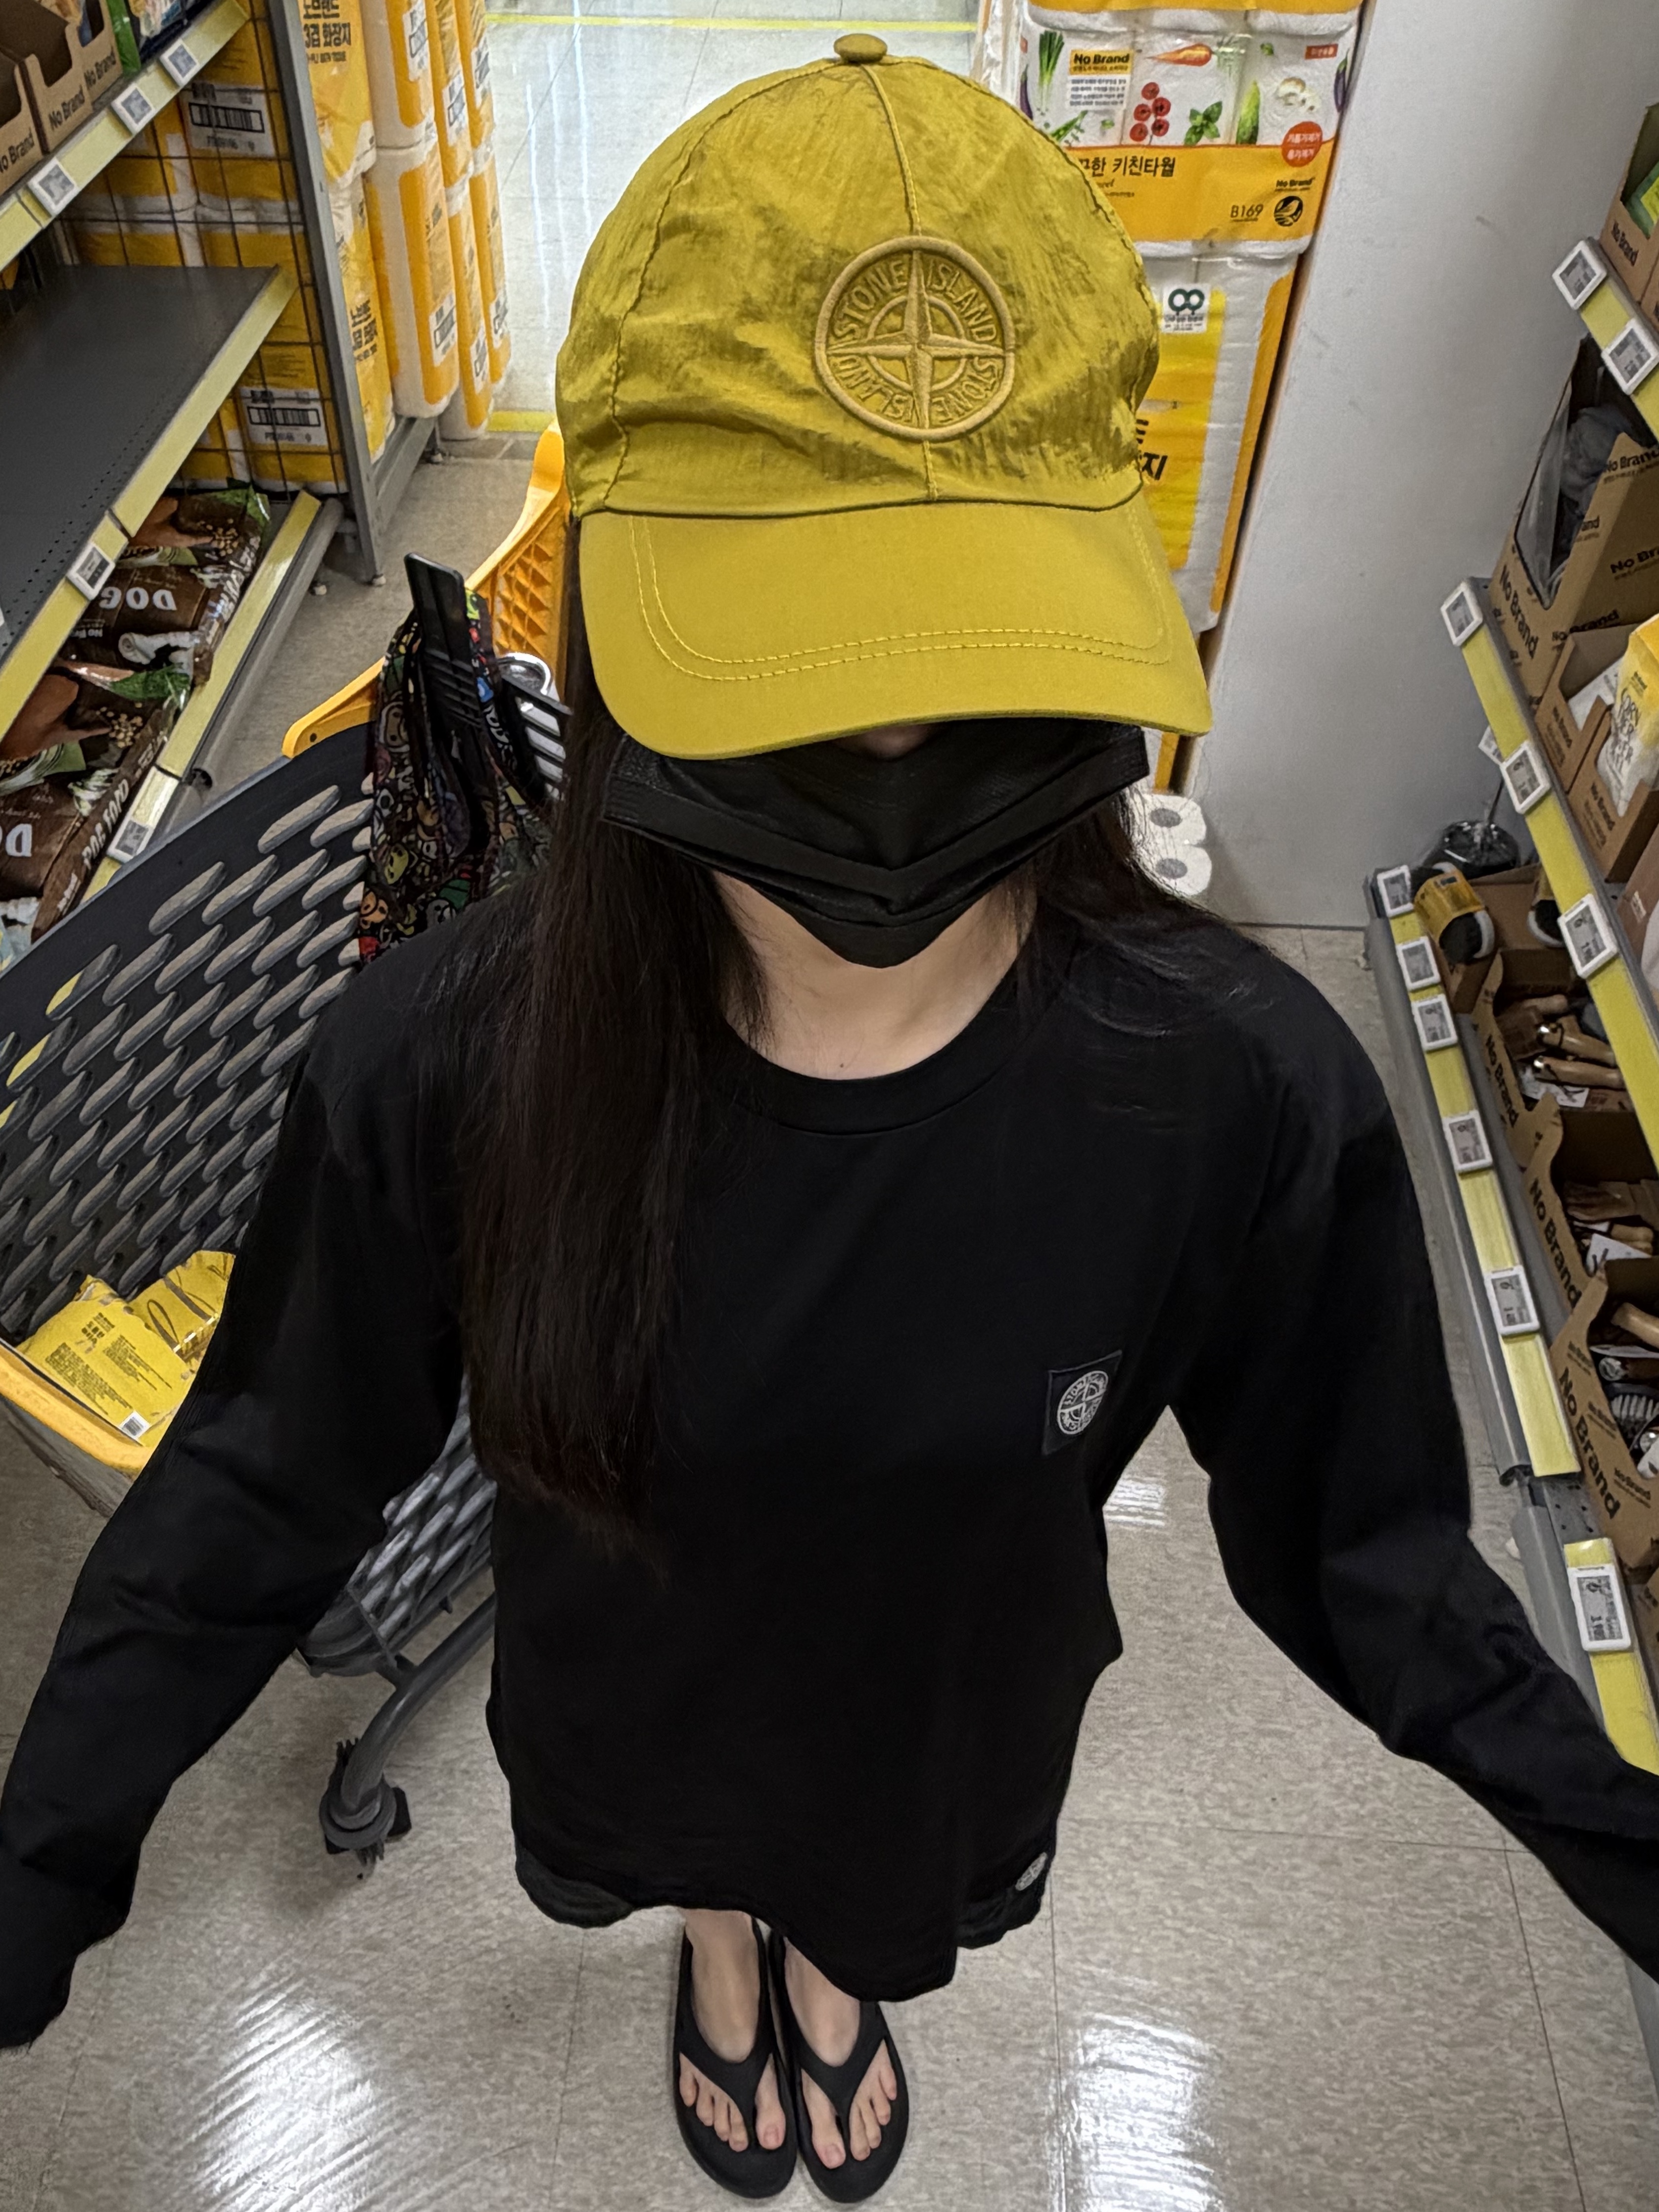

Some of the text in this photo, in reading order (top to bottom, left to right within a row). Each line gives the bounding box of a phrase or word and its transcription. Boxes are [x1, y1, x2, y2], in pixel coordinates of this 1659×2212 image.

[84, 47, 116, 88] No Brand
[1074, 53, 1130, 64] No Brand
[48, 84, 86, 131] No Brand
[8, 127, 35, 165] Brand
[1112, 155, 1176, 177] 키친타월
[1230, 203, 1264, 218] B169
[833, 260, 997, 342] STONE ISLAND
[837, 354, 1000, 423] STONE ISLAND
[1611, 559, 1634, 573] No
[99, 586, 177, 611] DOG
[1499, 564, 1539, 659] No Brand
[1485, 1034, 1519, 1128] No Brand
[1529, 1177, 1582, 1309] No Brand
[1560, 1366, 1621, 1519] No Brand
